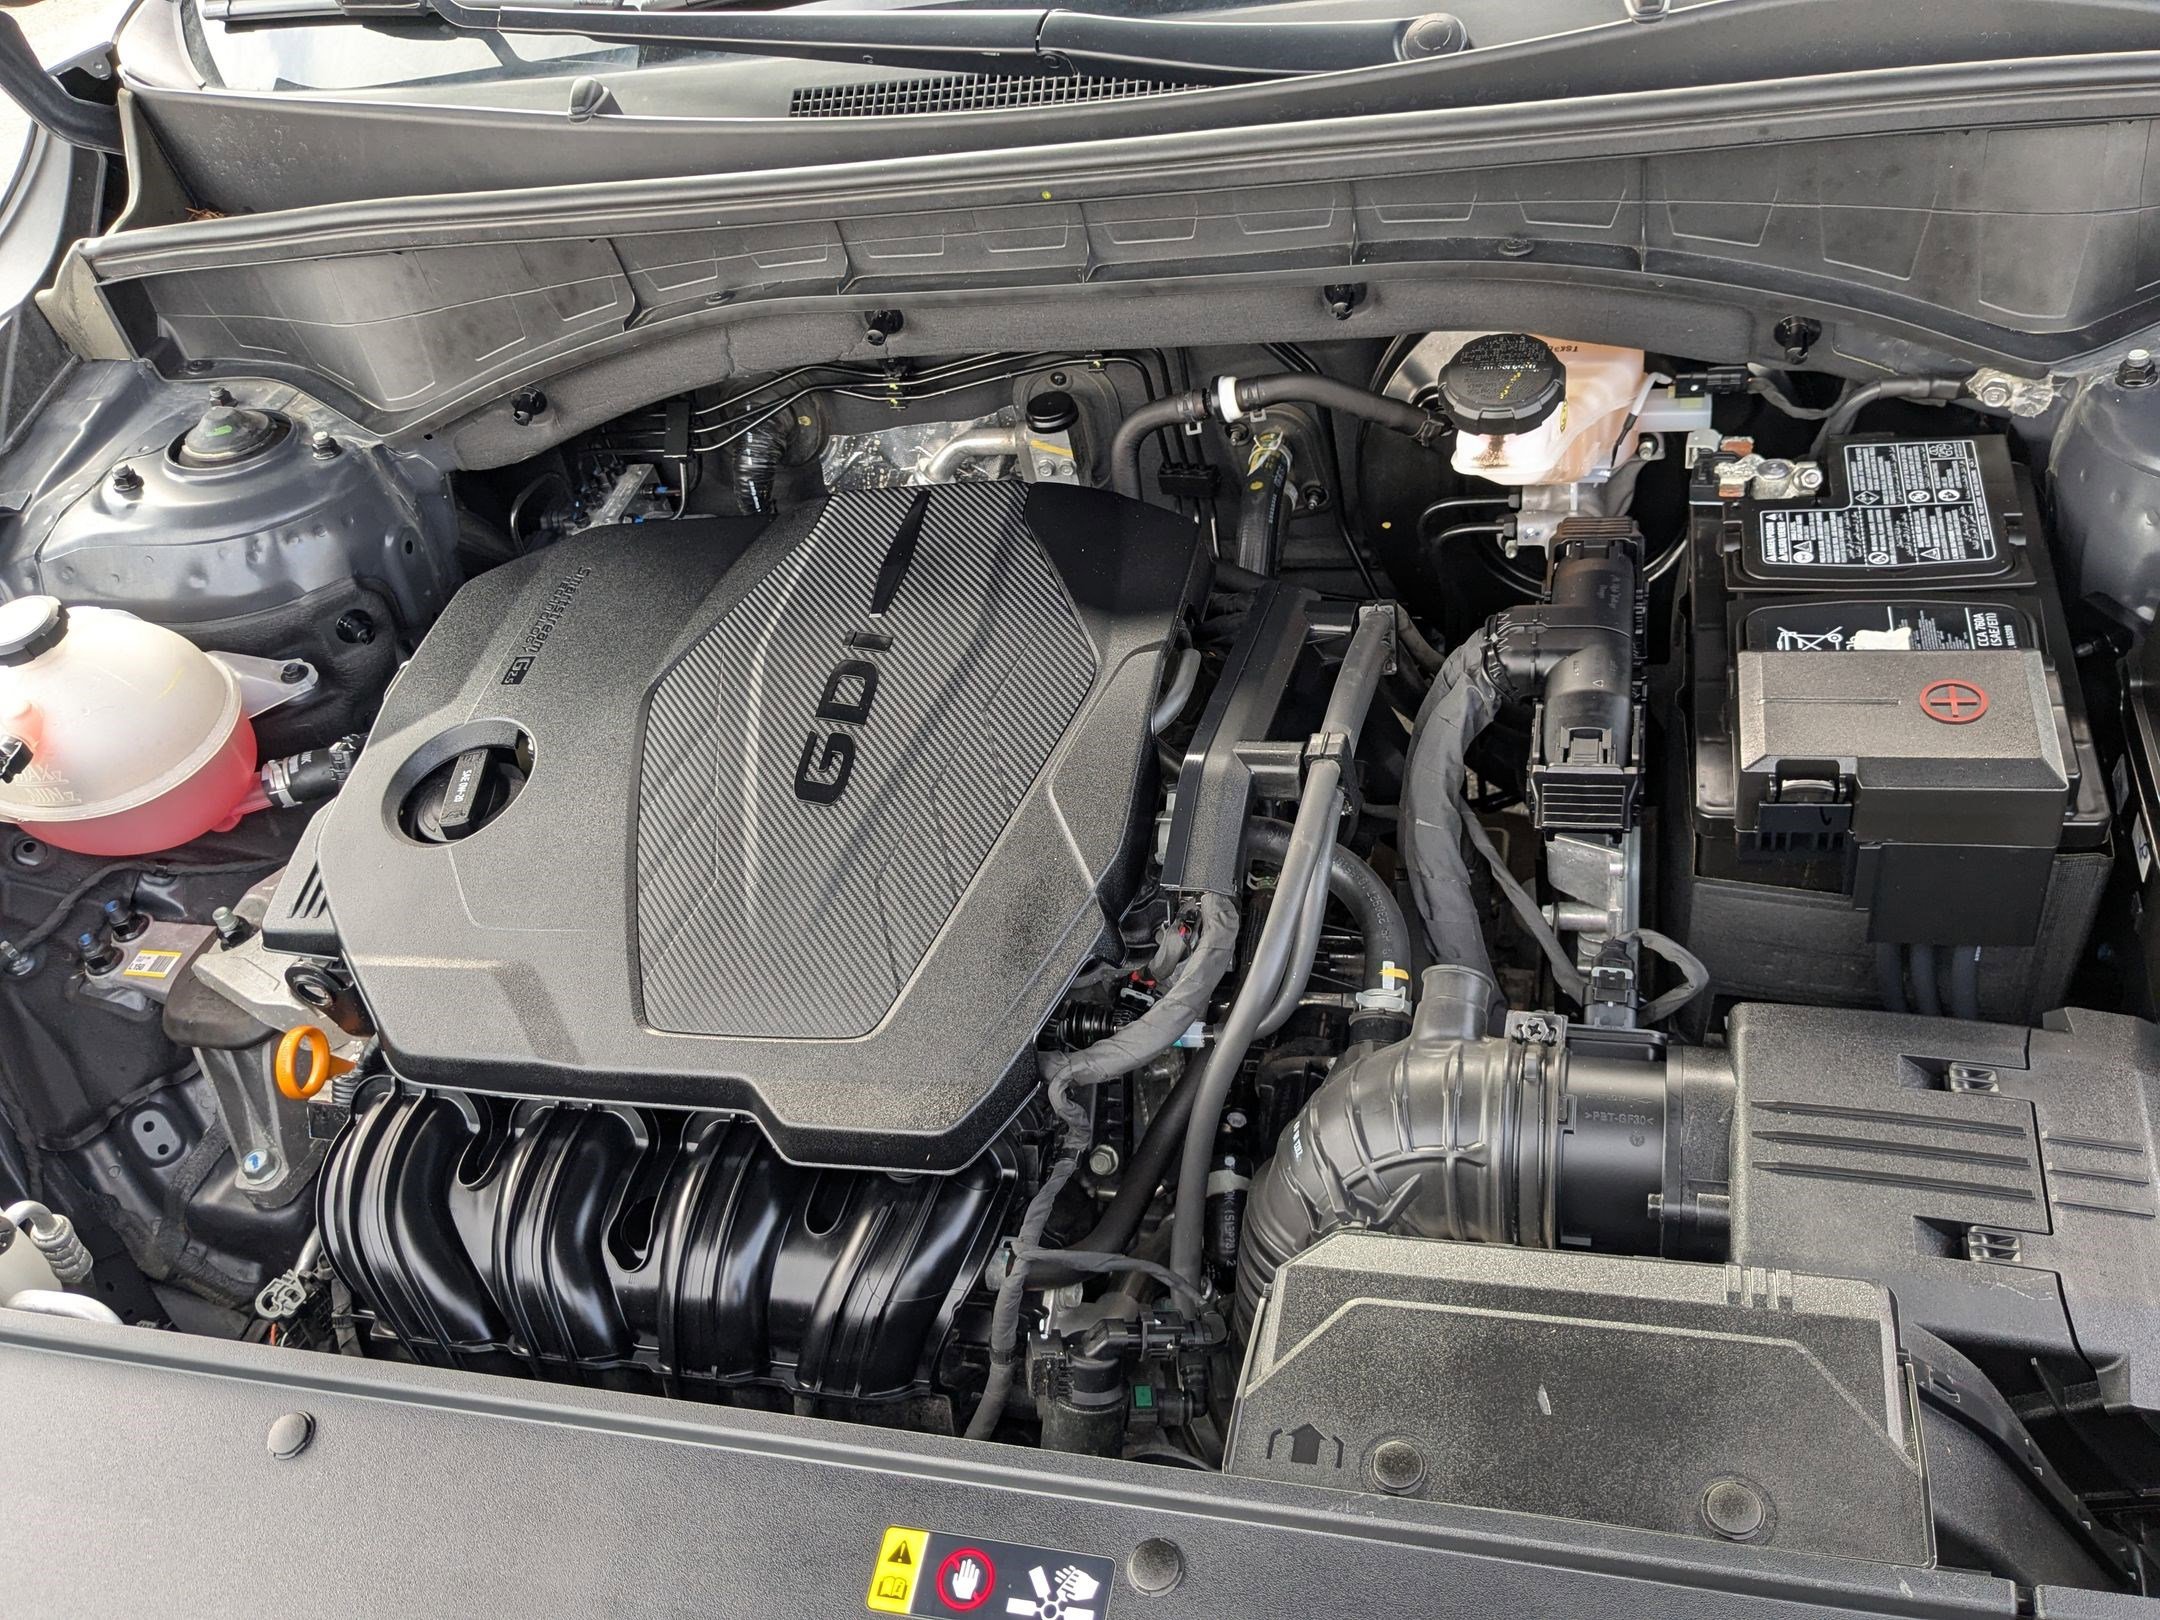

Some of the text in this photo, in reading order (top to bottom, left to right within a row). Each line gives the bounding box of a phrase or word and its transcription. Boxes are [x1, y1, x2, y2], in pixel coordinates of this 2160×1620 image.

[521, 575, 573, 653] TECHNOLOGY
[528, 566, 592, 653] Smartstream
[1972, 612, 1990, 647] CCA 760A
[460, 769, 473, 782] SAE
